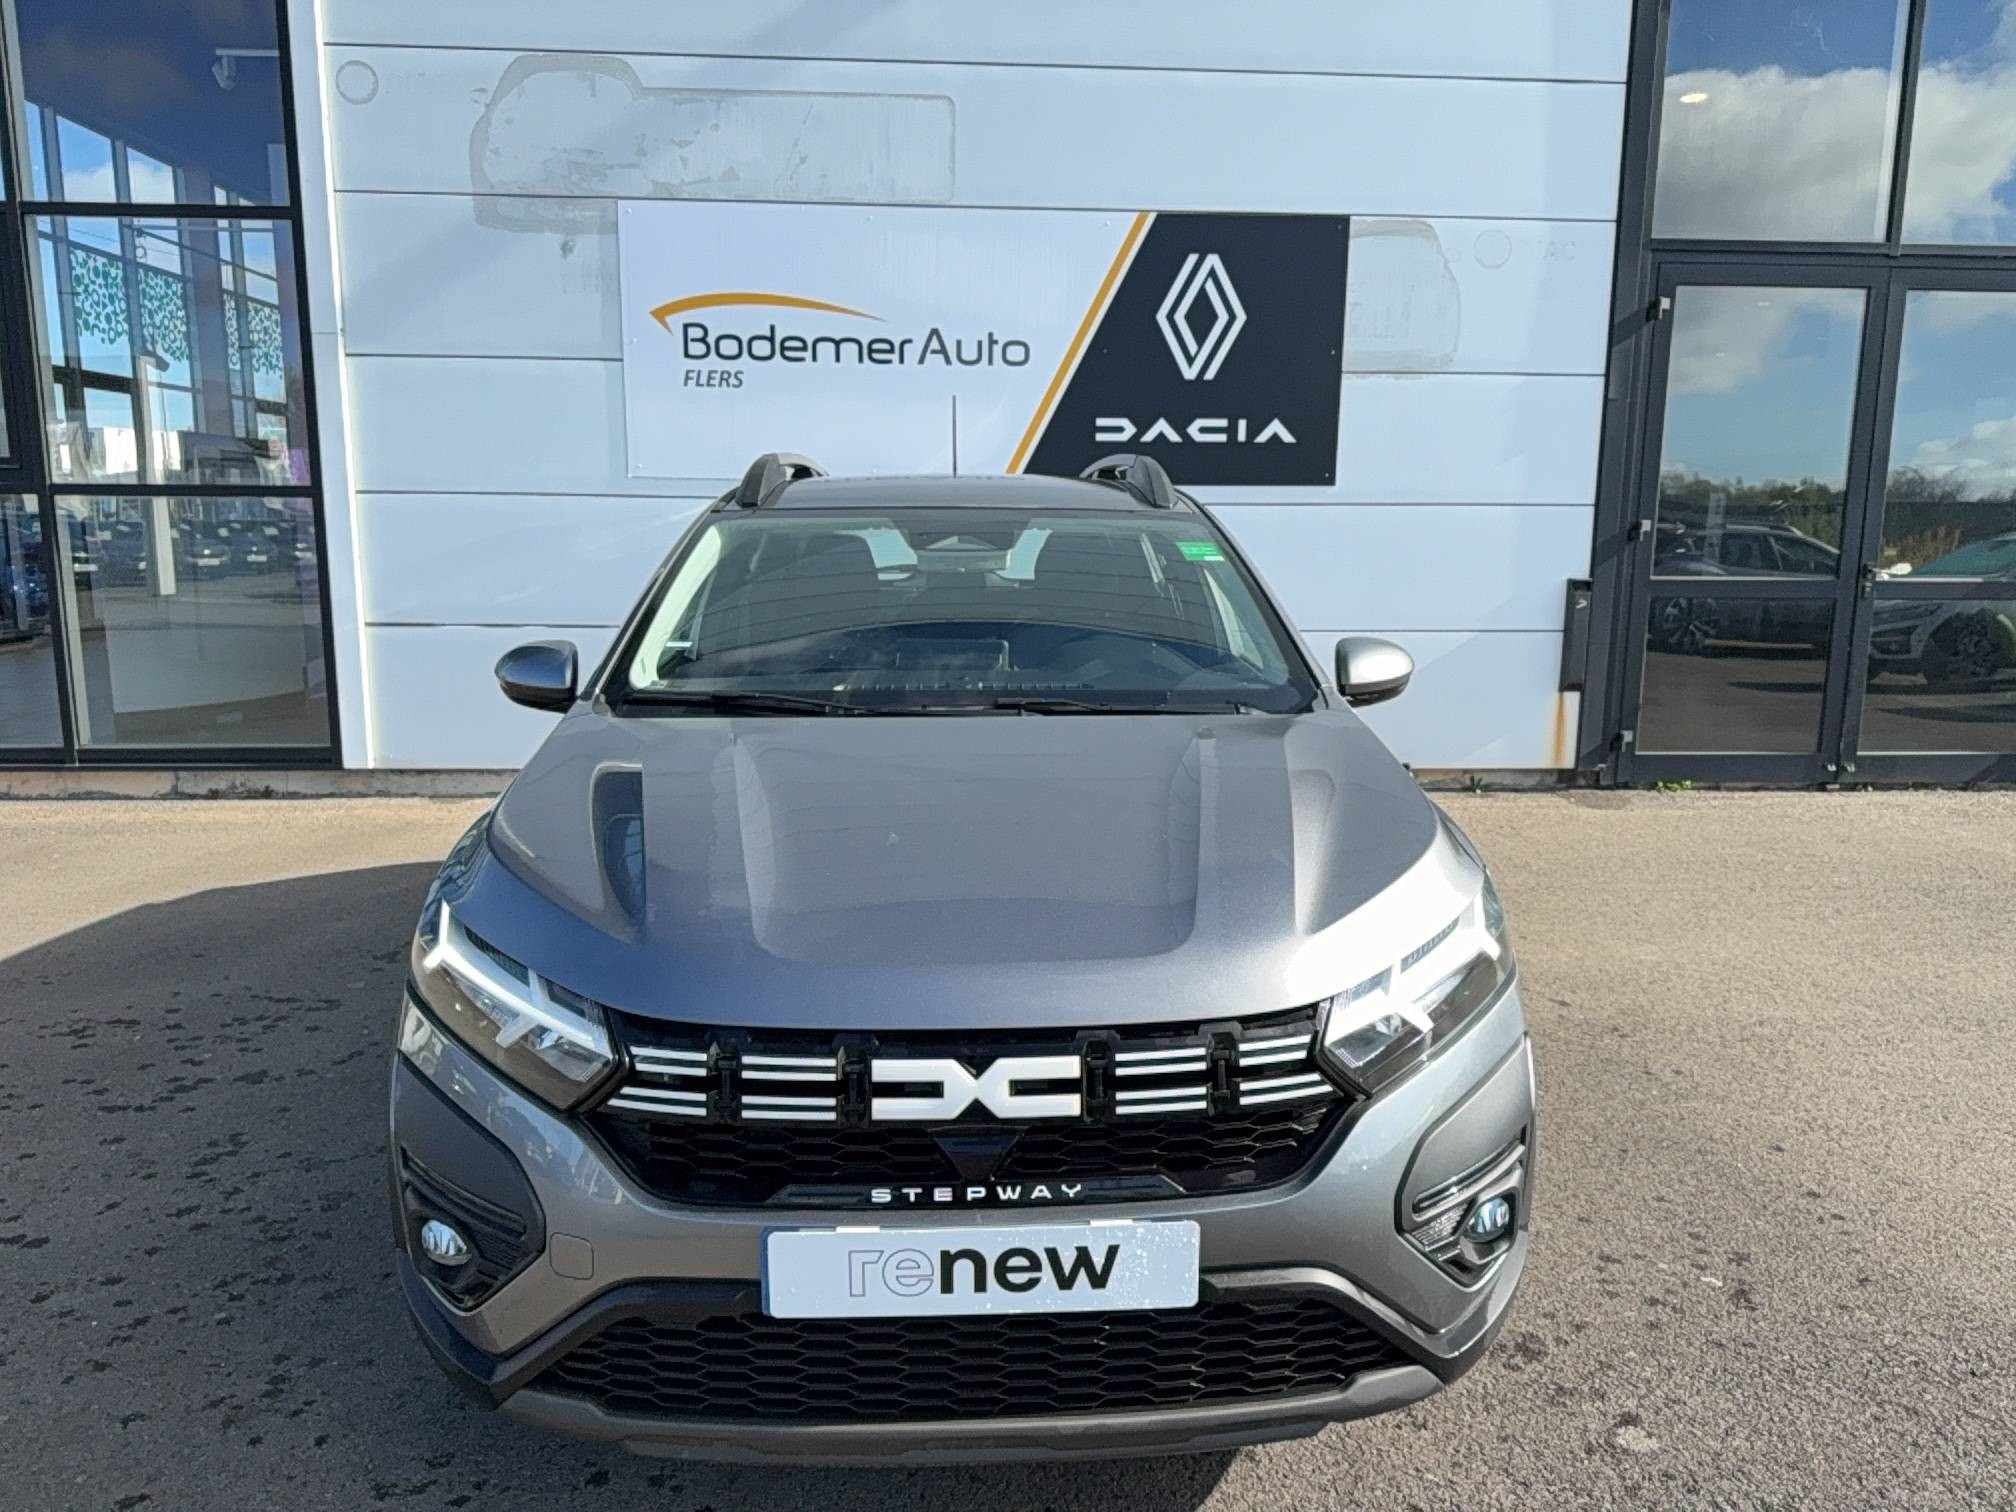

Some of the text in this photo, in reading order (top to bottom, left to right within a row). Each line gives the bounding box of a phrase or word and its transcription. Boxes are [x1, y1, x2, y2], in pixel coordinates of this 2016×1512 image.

[683, 369, 744, 388] FLERS
[1095, 417, 1296, 443] DACIA
[871, 1183, 1082, 1203] STEPWAY
[848, 1243, 1120, 1297] renew
